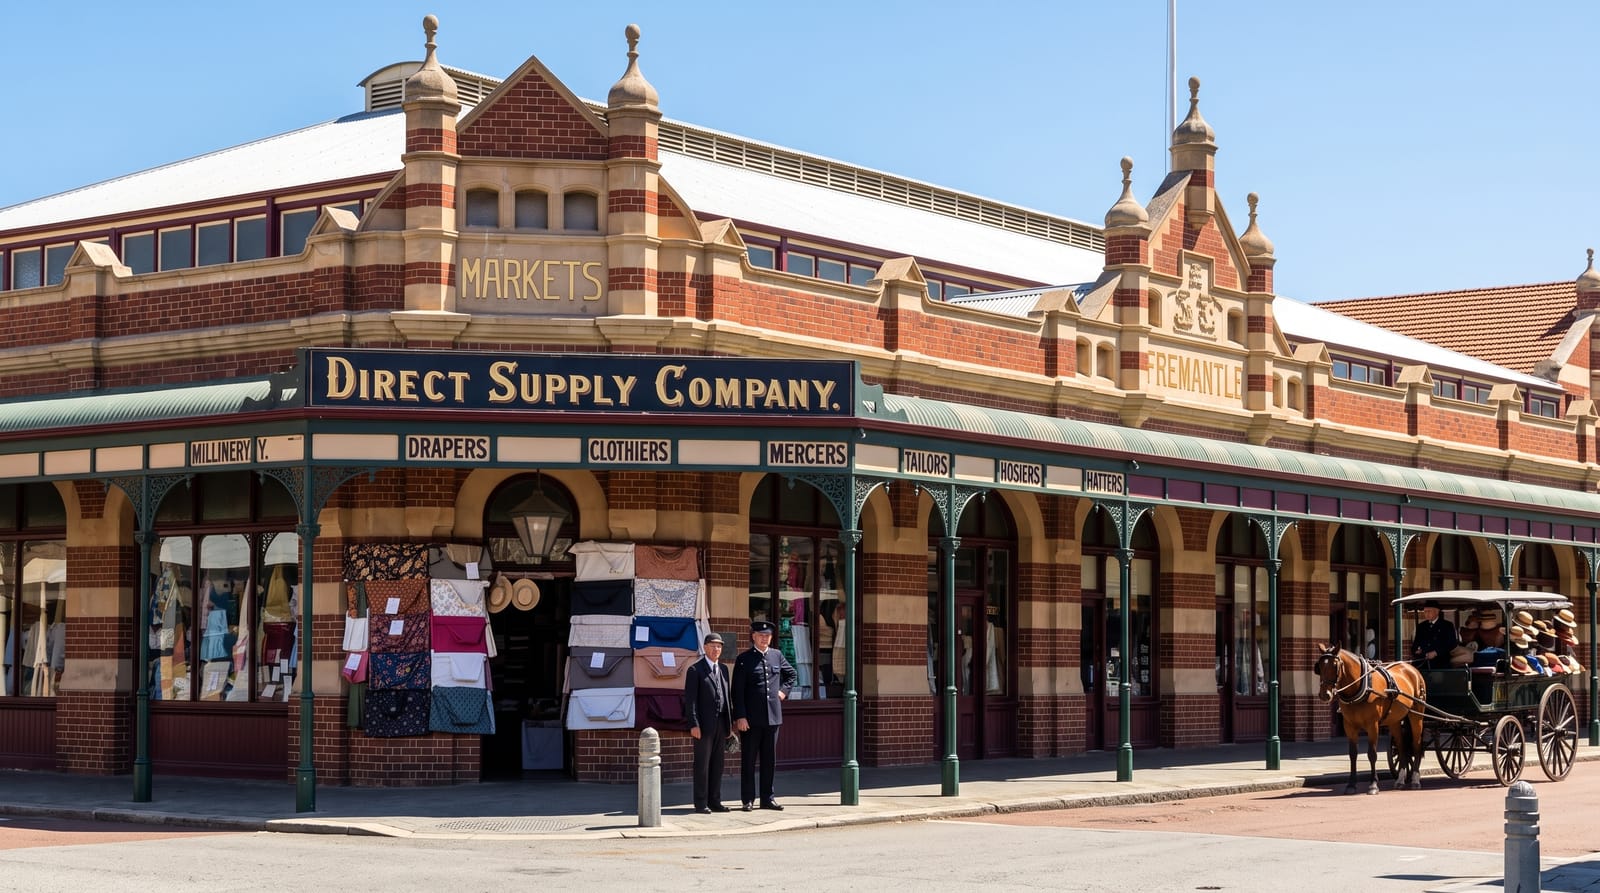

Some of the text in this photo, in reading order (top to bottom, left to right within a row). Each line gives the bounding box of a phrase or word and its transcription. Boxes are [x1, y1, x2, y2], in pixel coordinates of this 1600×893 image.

[462, 257, 602, 301] MARKETS
[325, 356, 841, 412] DIRECT SUPPLY COMPANY.
[1147, 350, 1242, 400] FREMANTLE
[192, 438, 269, 465] MILLINERY Y.
[408, 437, 488, 459] DRAPERS
[589, 440, 669, 462] CLOTHIERS
[769, 443, 847, 466] MERCERS
[904, 451, 948, 476] TAILORS
[1000, 459, 1041, 485] HOSIERS
[1086, 471, 1123, 494] HATTERS
